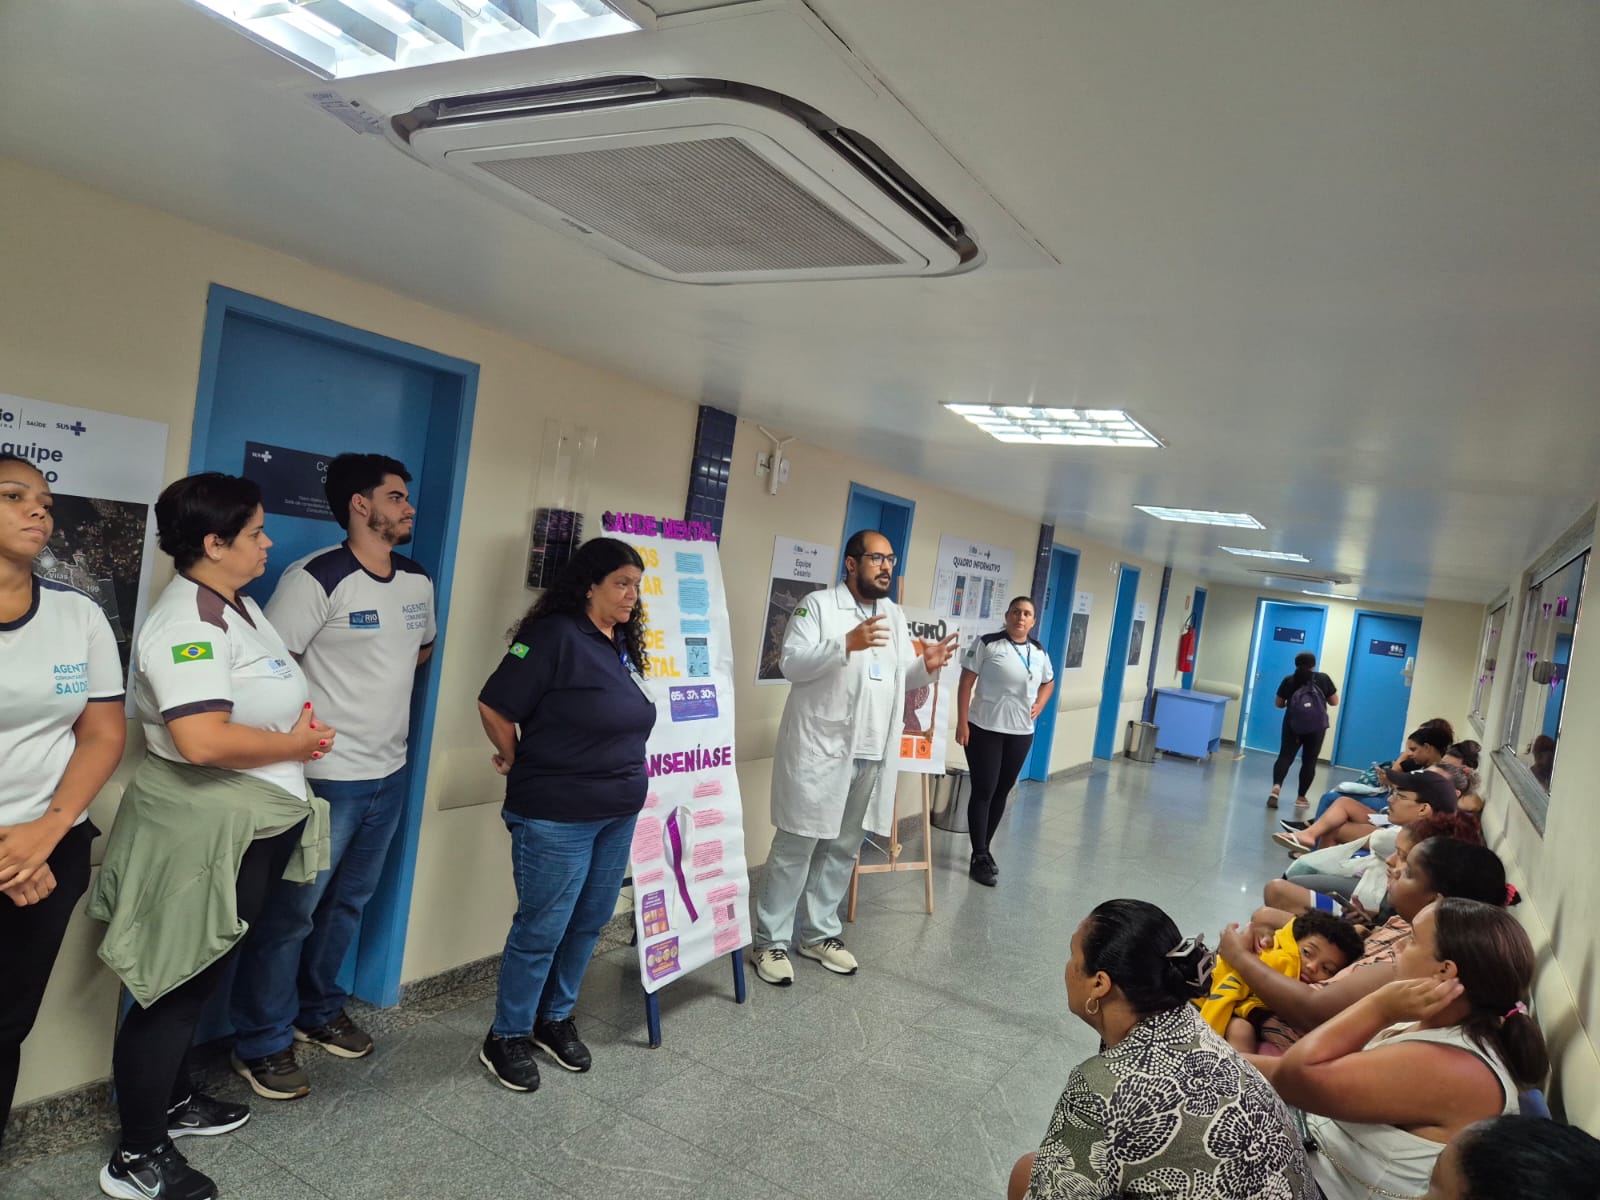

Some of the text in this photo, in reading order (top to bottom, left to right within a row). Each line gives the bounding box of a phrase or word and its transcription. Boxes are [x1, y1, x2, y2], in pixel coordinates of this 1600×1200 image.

[0, 408, 14, 423] io
[56, 422, 70, 430] SUS
[1, 442, 63, 463] quipe
[953, 556, 1001, 573] QUADRO INFORMATIVO
